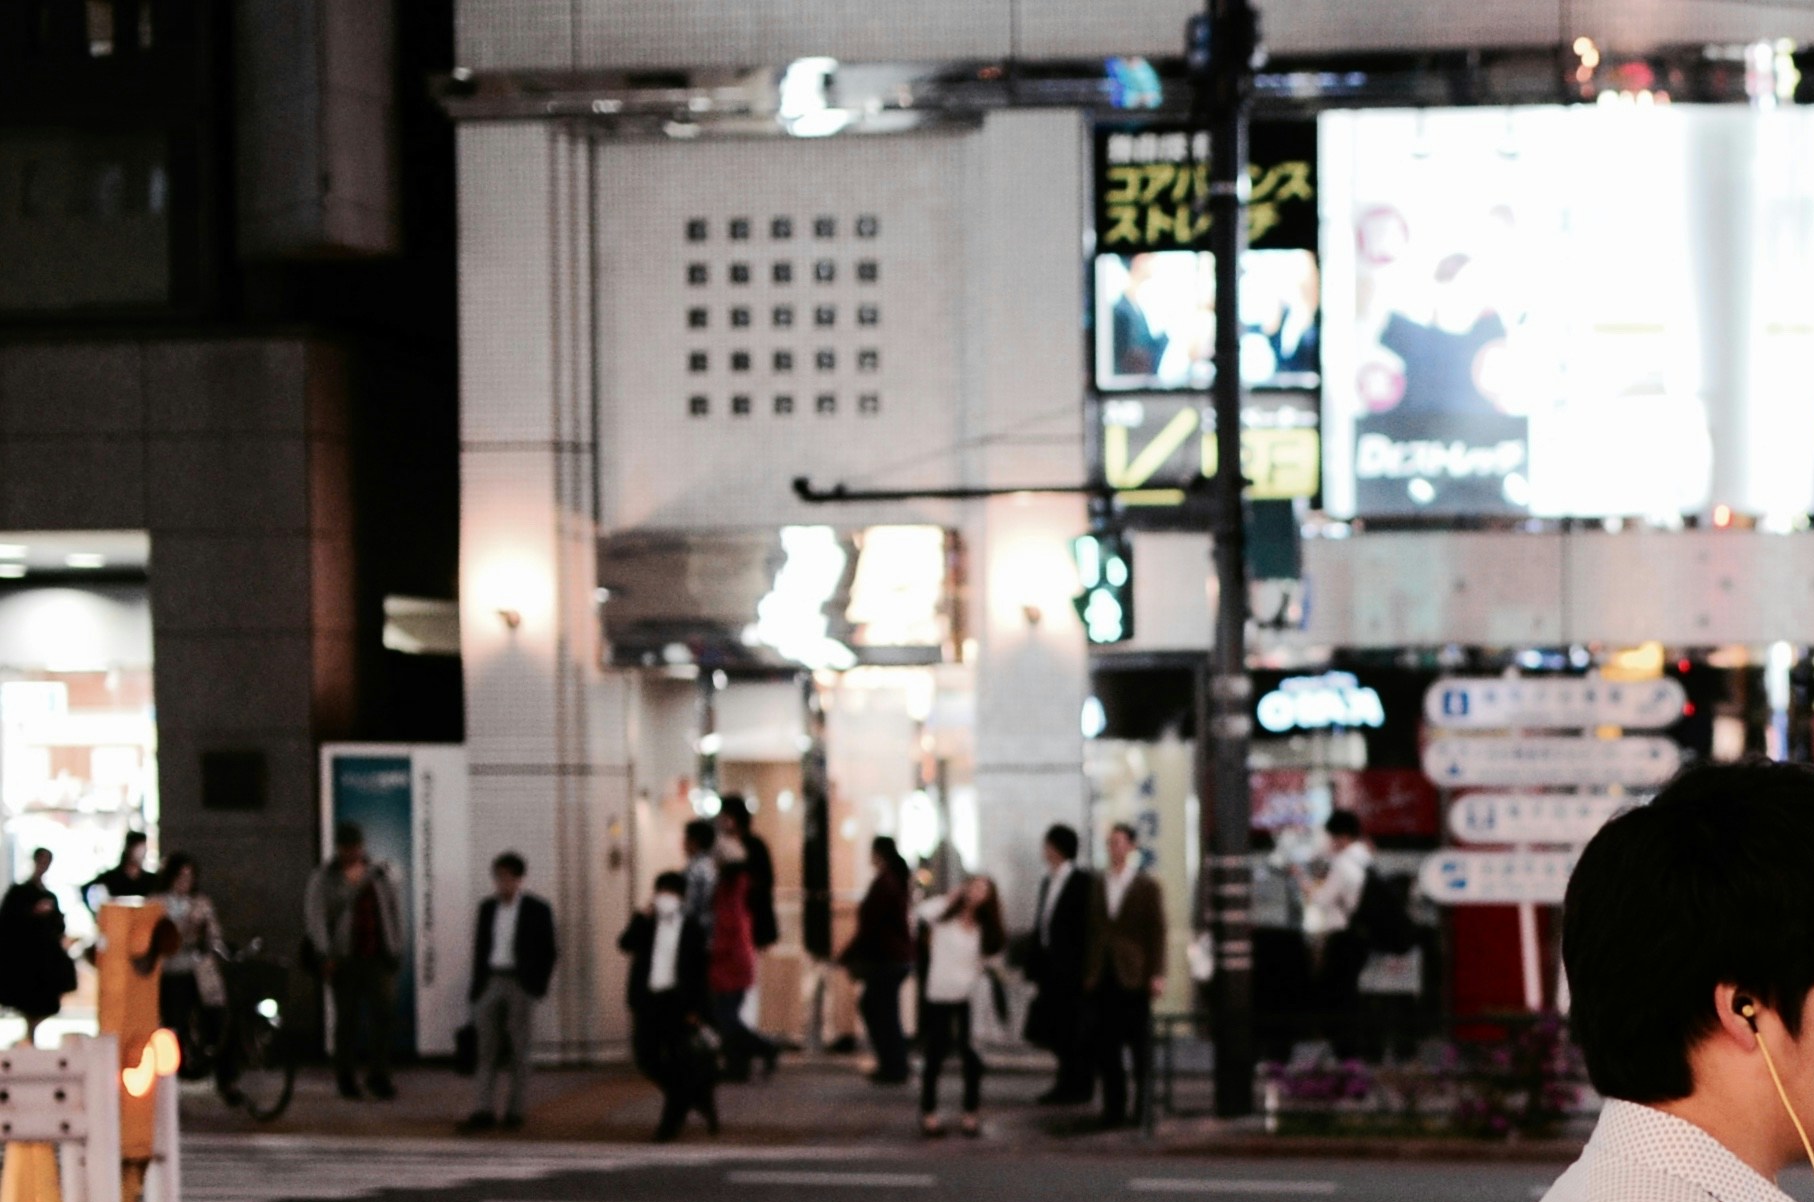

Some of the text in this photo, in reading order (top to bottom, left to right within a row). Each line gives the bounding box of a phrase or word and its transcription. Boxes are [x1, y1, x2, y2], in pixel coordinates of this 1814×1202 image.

[1106, 161, 1313, 202] コアバンス
[1104, 202, 1281, 246] ストレチ
